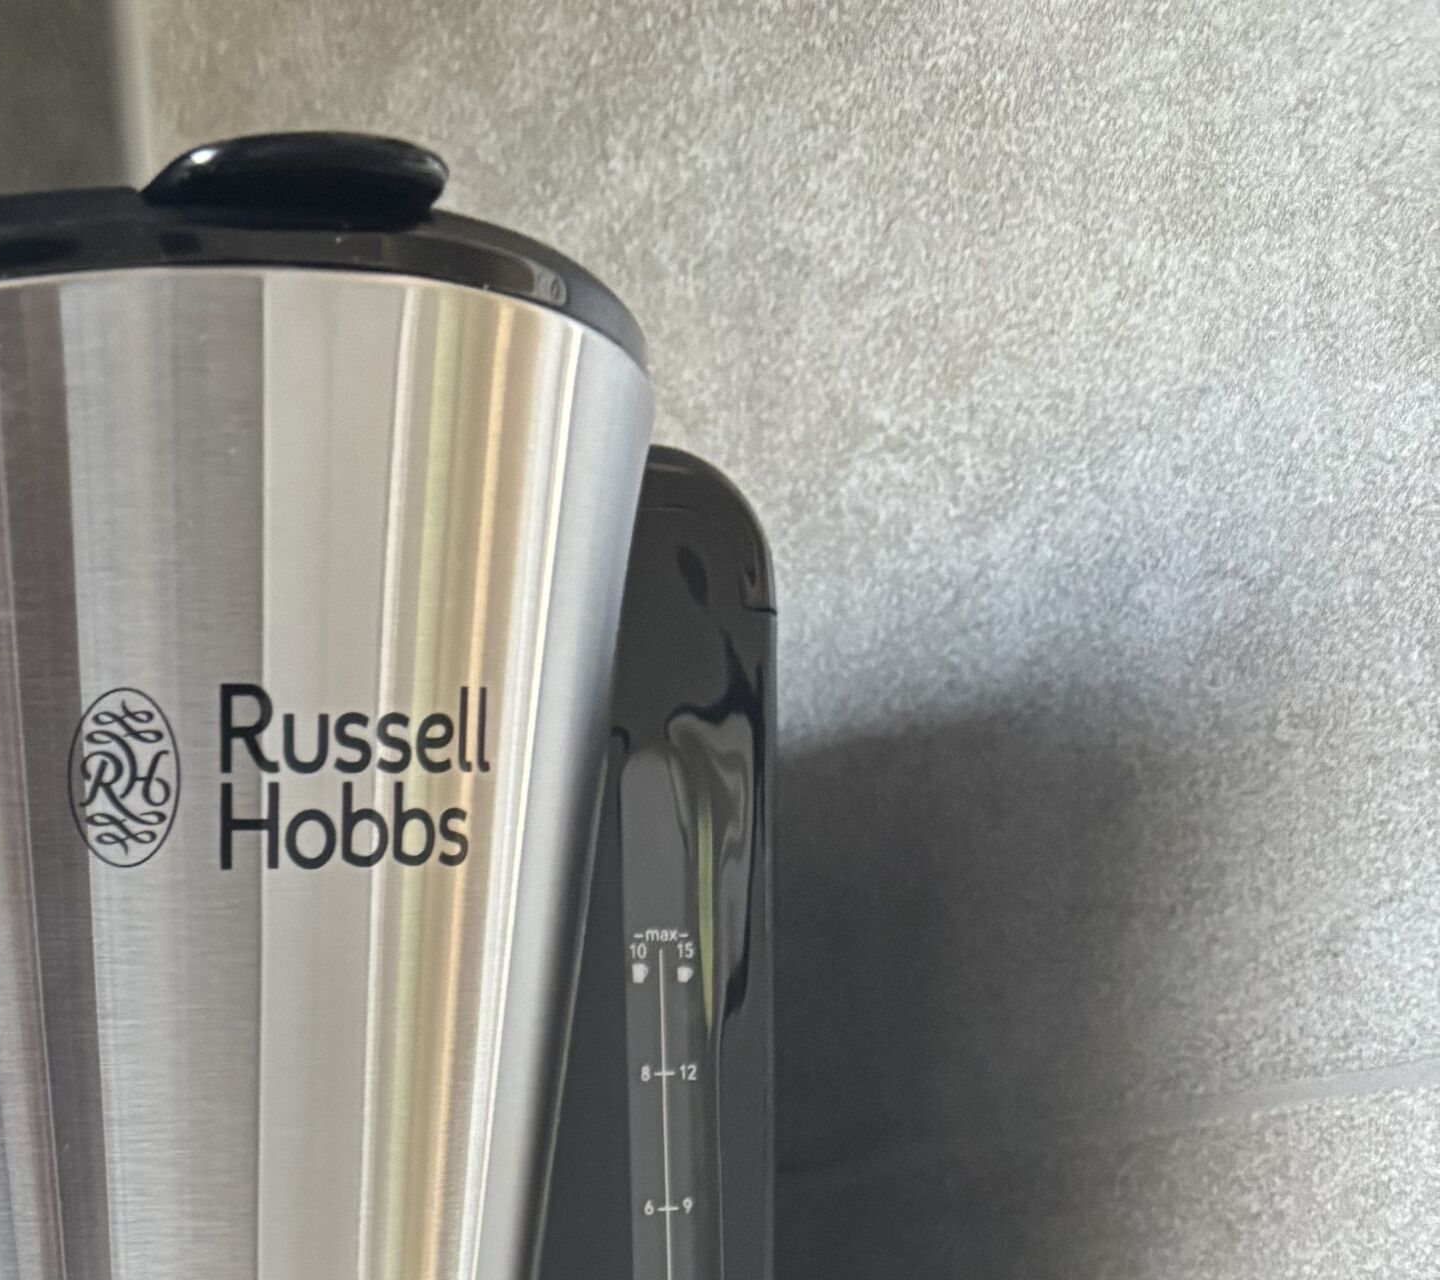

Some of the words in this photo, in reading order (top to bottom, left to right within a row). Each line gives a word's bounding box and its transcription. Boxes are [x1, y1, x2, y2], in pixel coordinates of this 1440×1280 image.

[219, 683, 490, 774] Russell
[219, 781, 469, 870] Hobbs
[629, 942, 647, 960] 10
[676, 941, 694, 959] 15
[640, 1064, 651, 1082] 8
[679, 1063, 697, 1081] 12
[643, 1199, 655, 1216] 6
[682, 1197, 693, 1214] 9
